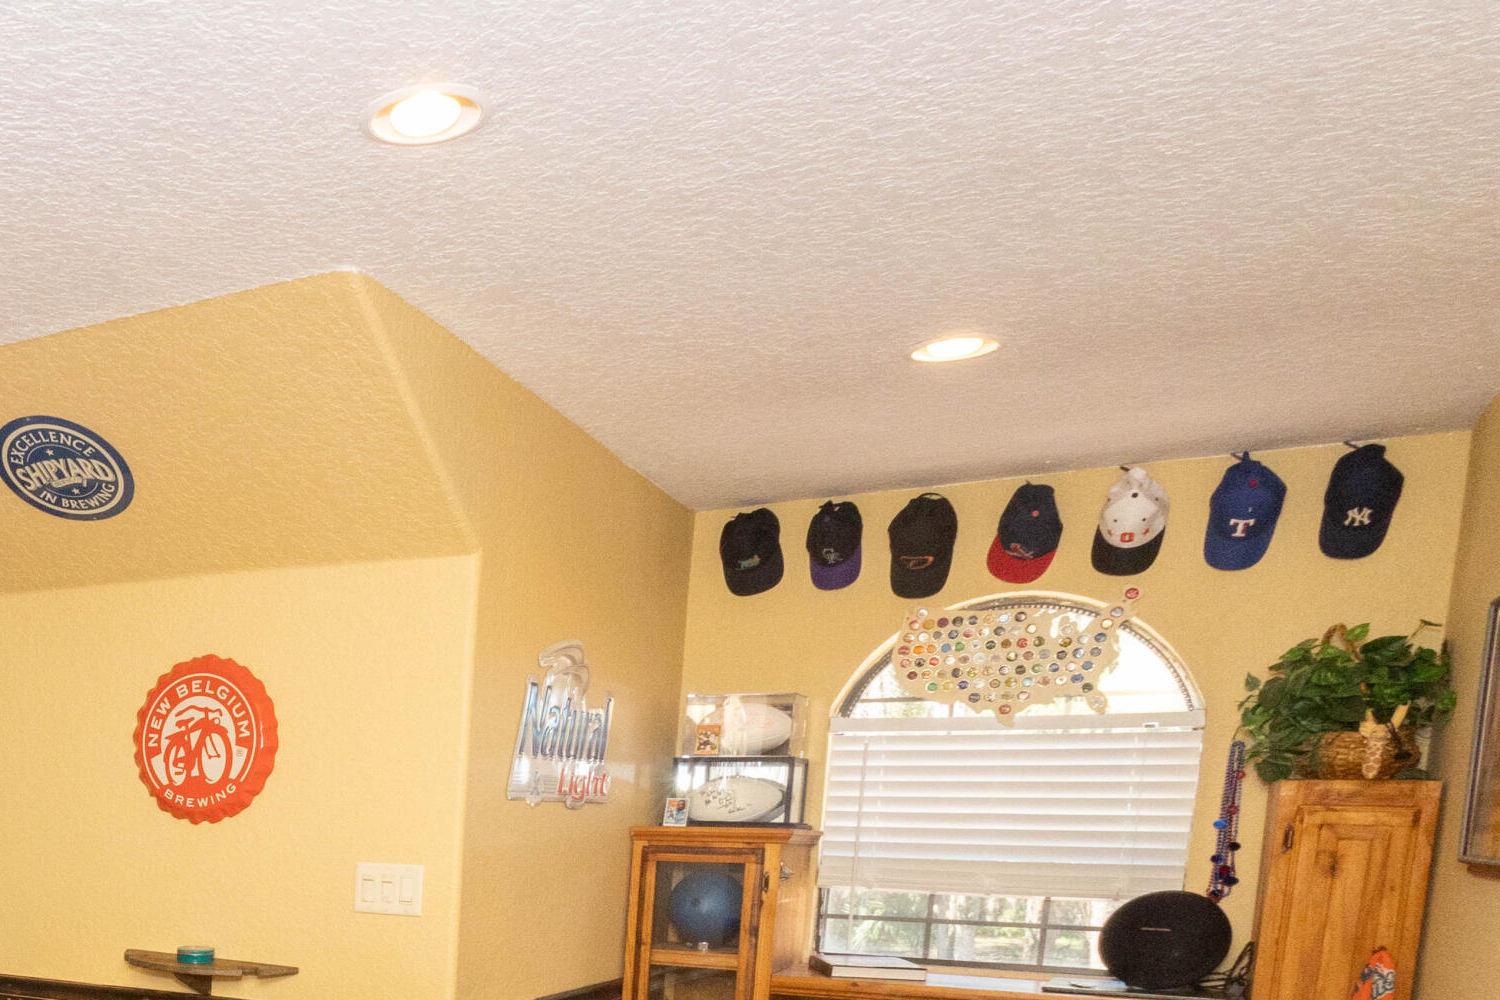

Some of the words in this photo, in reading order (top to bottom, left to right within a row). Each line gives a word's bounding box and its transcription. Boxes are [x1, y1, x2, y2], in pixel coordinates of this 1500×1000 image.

[11, 431, 95, 465] EXCELLENCE
[15, 457, 116, 491] SHIPYARD
[40, 490, 57, 504] IN
[62, 482, 115, 510] BREWING
[1229, 518, 1255, 537] T
[148, 697, 172, 747] NEW
[176, 680, 250, 738] BELGIUM
[519, 682, 612, 762] Natural
[164, 783, 236, 808] BREWING
